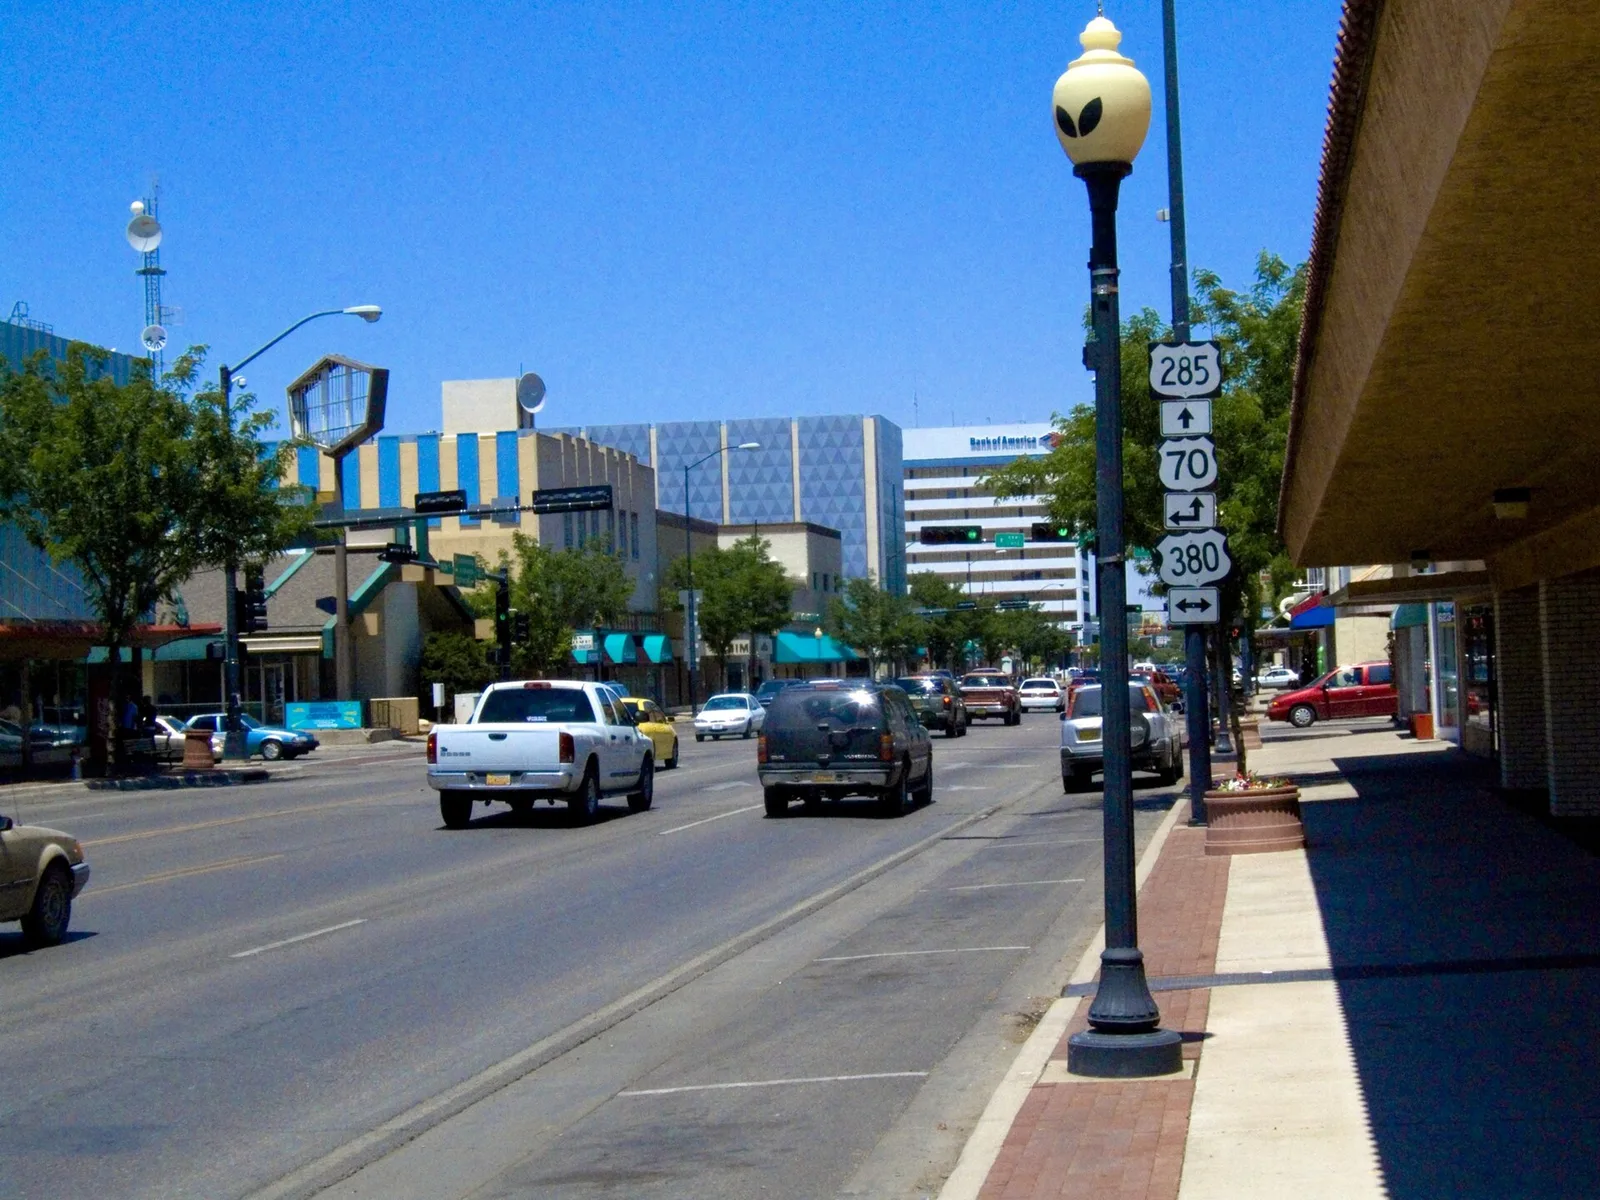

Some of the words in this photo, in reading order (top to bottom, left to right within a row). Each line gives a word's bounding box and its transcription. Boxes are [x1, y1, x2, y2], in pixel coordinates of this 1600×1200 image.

[1161, 354, 1209, 387] 285
[970, 437, 992, 447] Bank
[992, 436, 1001, 446] of
[1002, 435, 1037, 446] America
[1166, 448, 1209, 481] 70
[1170, 541, 1220, 577] 380
